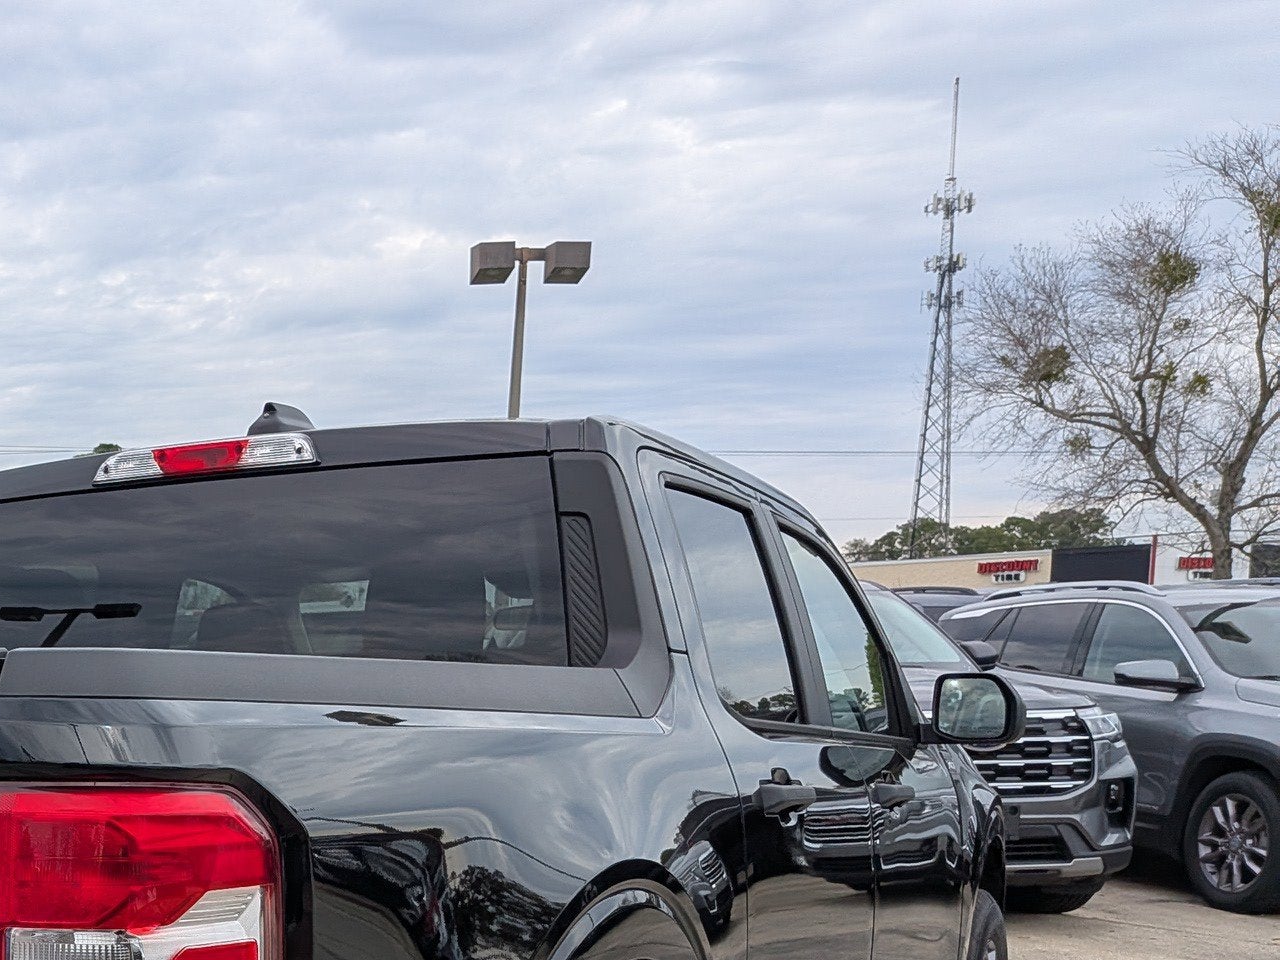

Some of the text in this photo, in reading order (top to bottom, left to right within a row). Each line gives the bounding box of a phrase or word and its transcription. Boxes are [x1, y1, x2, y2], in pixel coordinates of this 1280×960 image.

[977, 559, 1039, 574] DISCOUNT
[1178, 556, 1214, 570] DISCO
[993, 573, 1021, 582] TIRE
